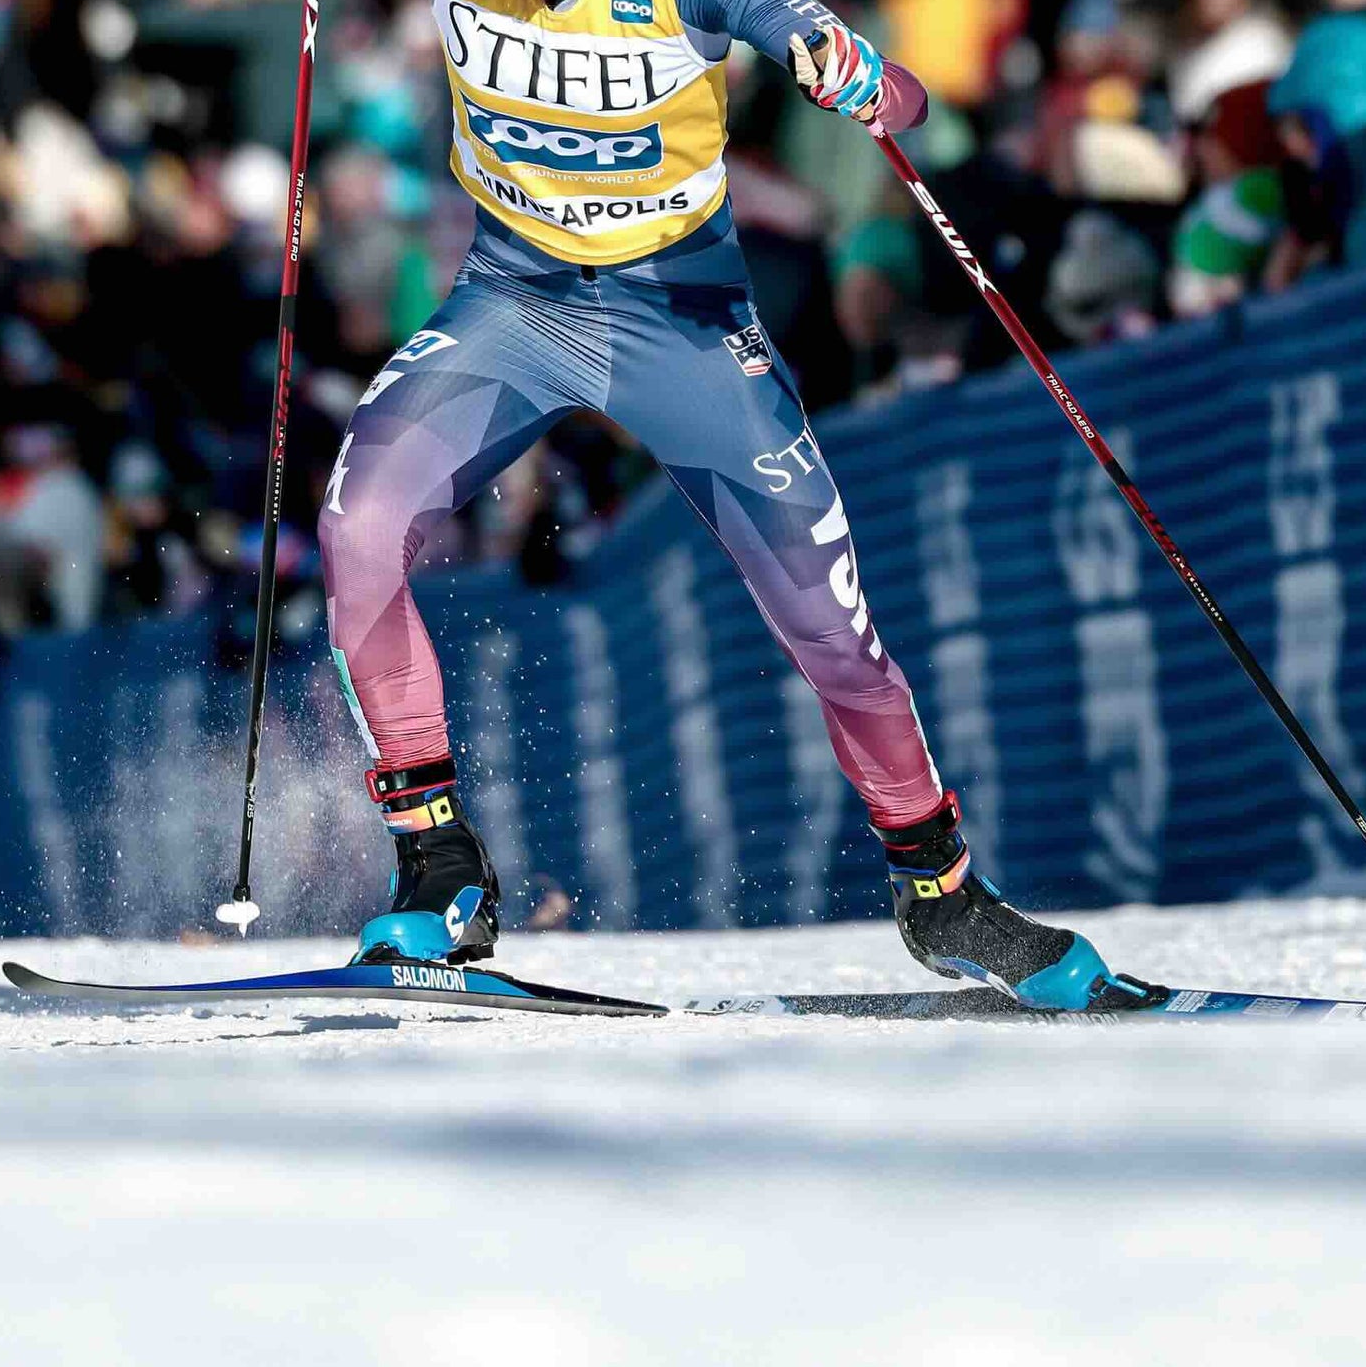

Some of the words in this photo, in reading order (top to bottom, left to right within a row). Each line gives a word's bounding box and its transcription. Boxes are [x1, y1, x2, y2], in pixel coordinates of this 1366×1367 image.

[445, 0, 680, 112] STIFEL
[294, 172, 304, 209] TRIAC
[583, 174, 635, 185] WORLD
[638, 167, 665, 183] CUP
[290, 227, 300, 262] AERO
[906, 180, 999, 294] SWIX
[725, 327, 761, 350] US
[1046, 372, 1069, 401] TRIAC
[1073, 414, 1095, 440] AERO
[391, 965, 467, 991] SALOMON
